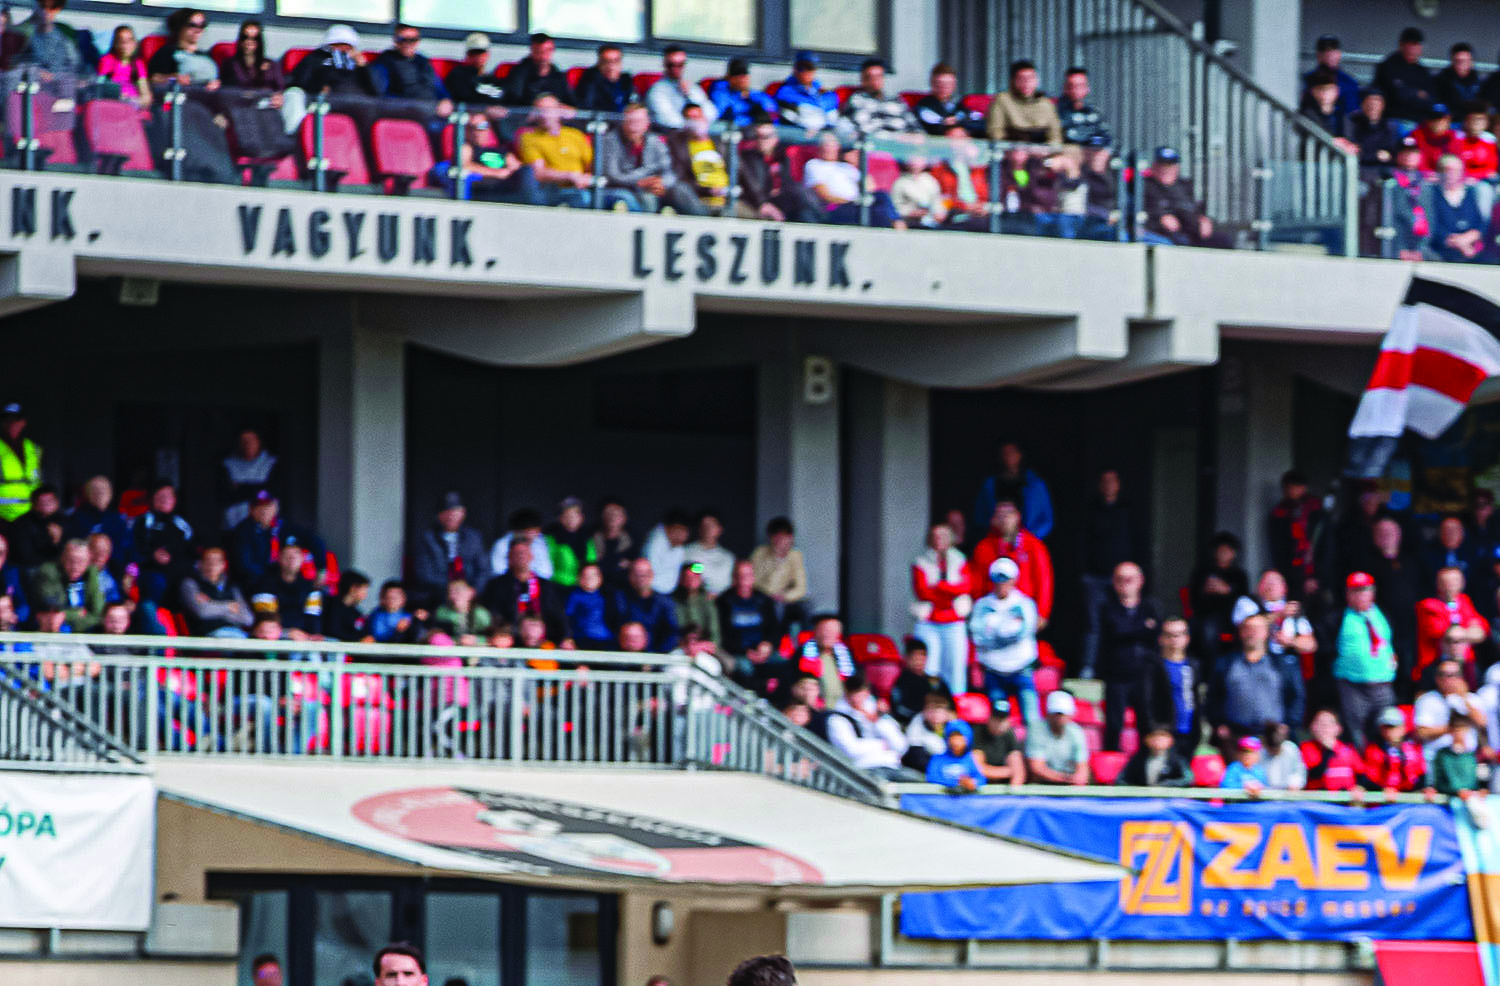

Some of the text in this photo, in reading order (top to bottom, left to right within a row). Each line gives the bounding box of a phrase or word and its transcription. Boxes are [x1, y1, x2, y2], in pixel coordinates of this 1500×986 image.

[237, 204, 499, 270] VAGYUNK.
[632, 226, 875, 293] LESZÜNK.
[805, 356, 831, 402] B
[1202, 821, 1433, 890] ZAEV
